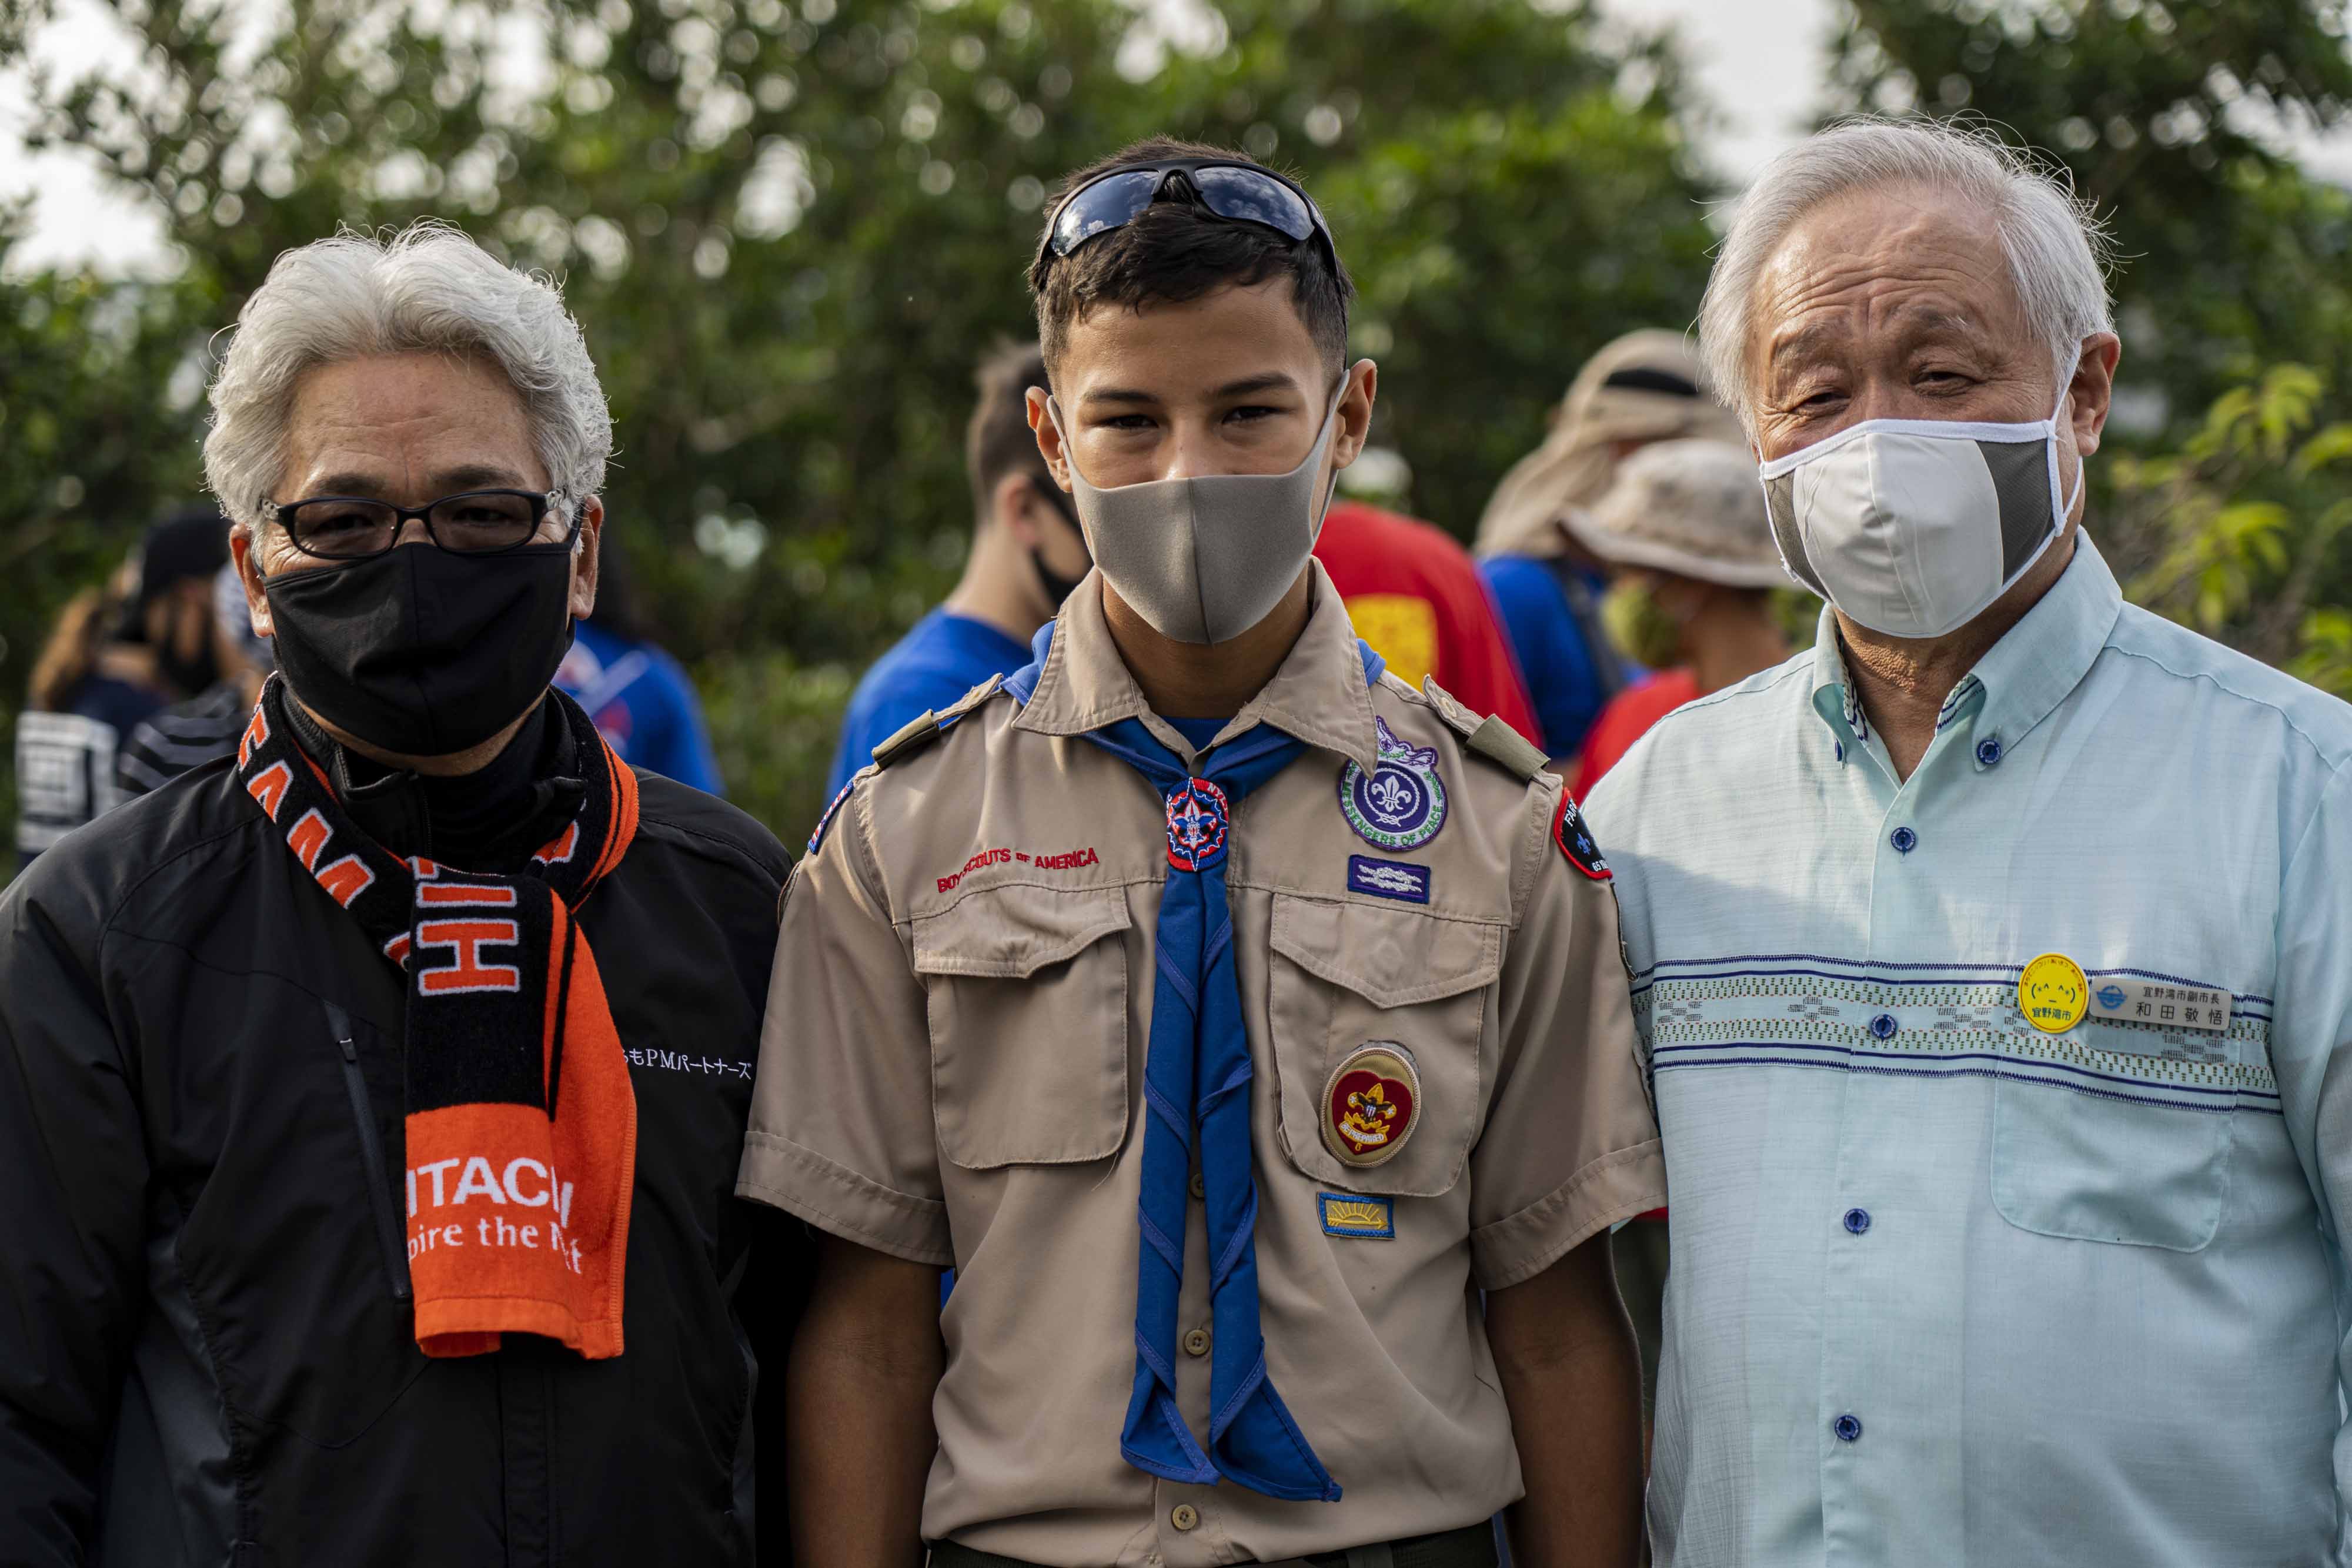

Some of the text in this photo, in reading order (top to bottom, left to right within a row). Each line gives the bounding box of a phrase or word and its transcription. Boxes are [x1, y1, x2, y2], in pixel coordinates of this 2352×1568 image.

[1401, 834, 1416, 846] OF
[1419, 805, 1443, 839] PEACE
[937, 847, 1100, 893] BOY SCOUTS OF AMERICA
[2143, 987, 2220, 1005] 宜野湾市副市長
[2032, 1007, 2072, 1021] 宜野湾市
[2136, 1001, 2224, 1026] 和田敬悟
[477, 1215, 539, 1248] the
